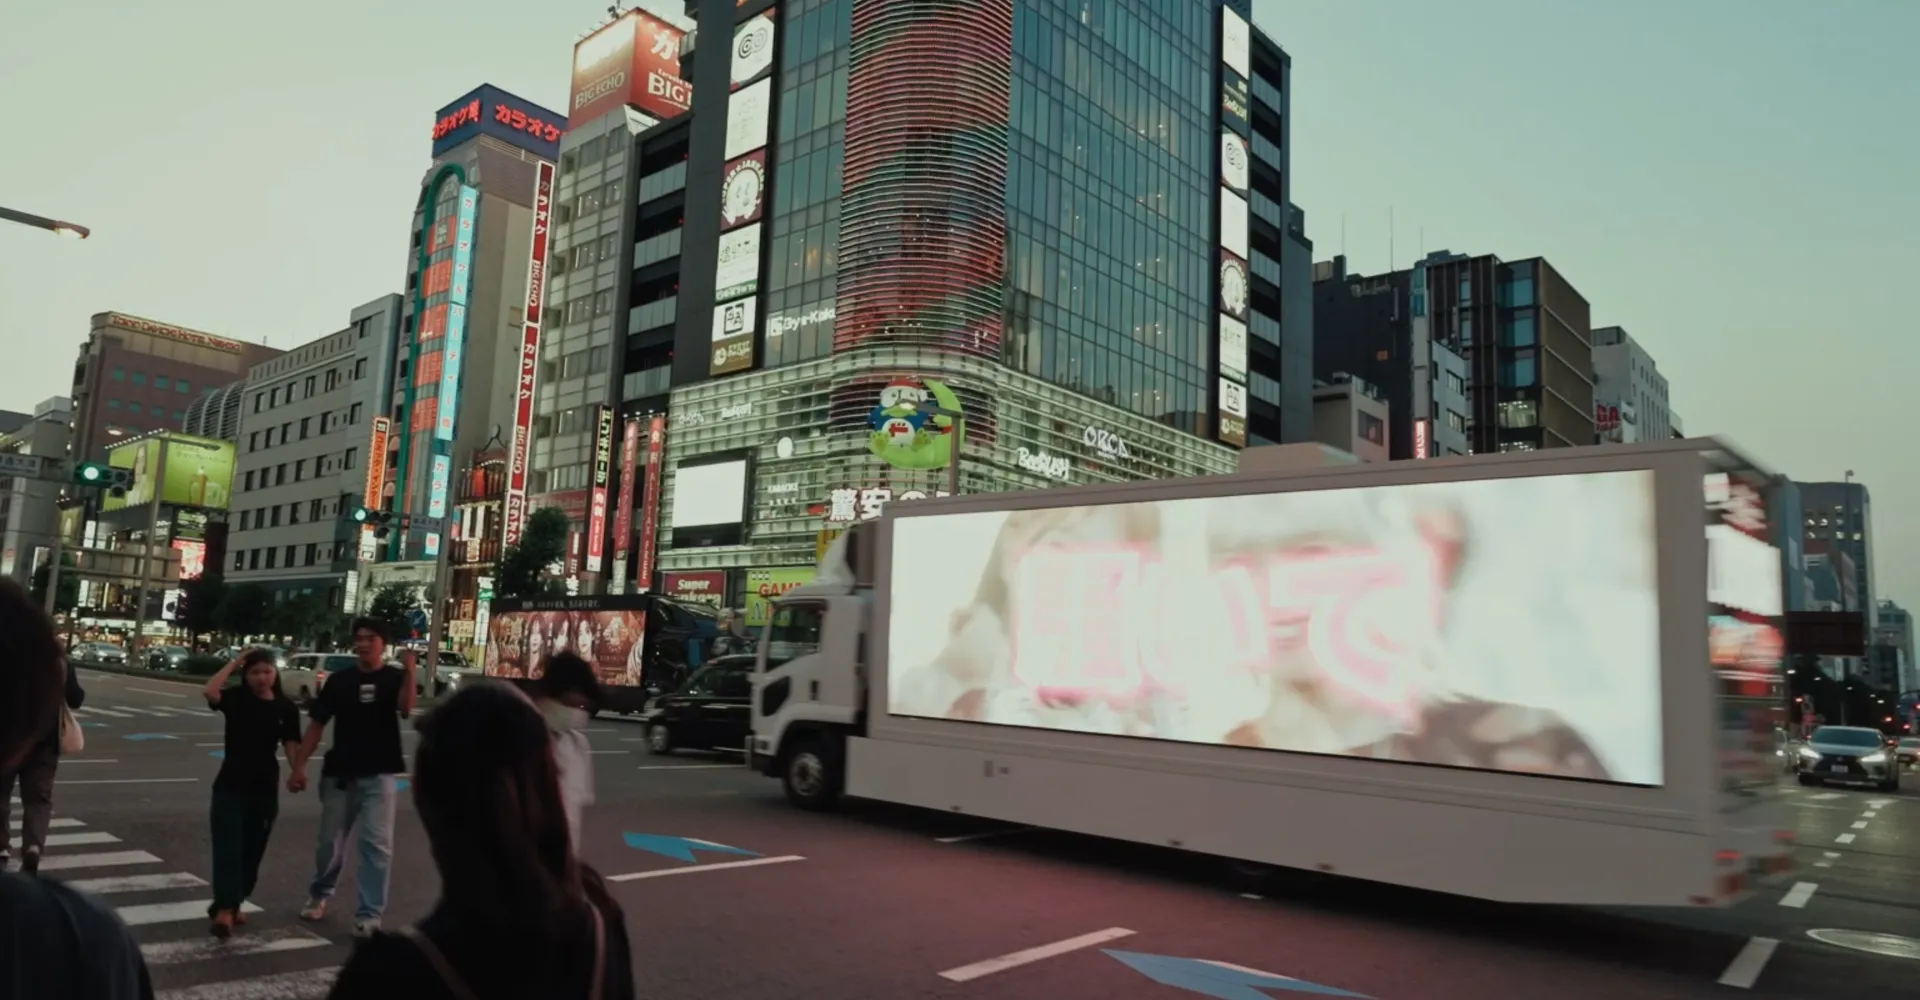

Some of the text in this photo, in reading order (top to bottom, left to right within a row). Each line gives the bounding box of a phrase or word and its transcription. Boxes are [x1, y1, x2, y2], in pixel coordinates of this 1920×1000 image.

[648, 71, 685, 103] BIG
[495, 103, 567, 143] カラオケ
[519, 342, 536, 400] カラオケ
[677, 578, 711, 592] Super
